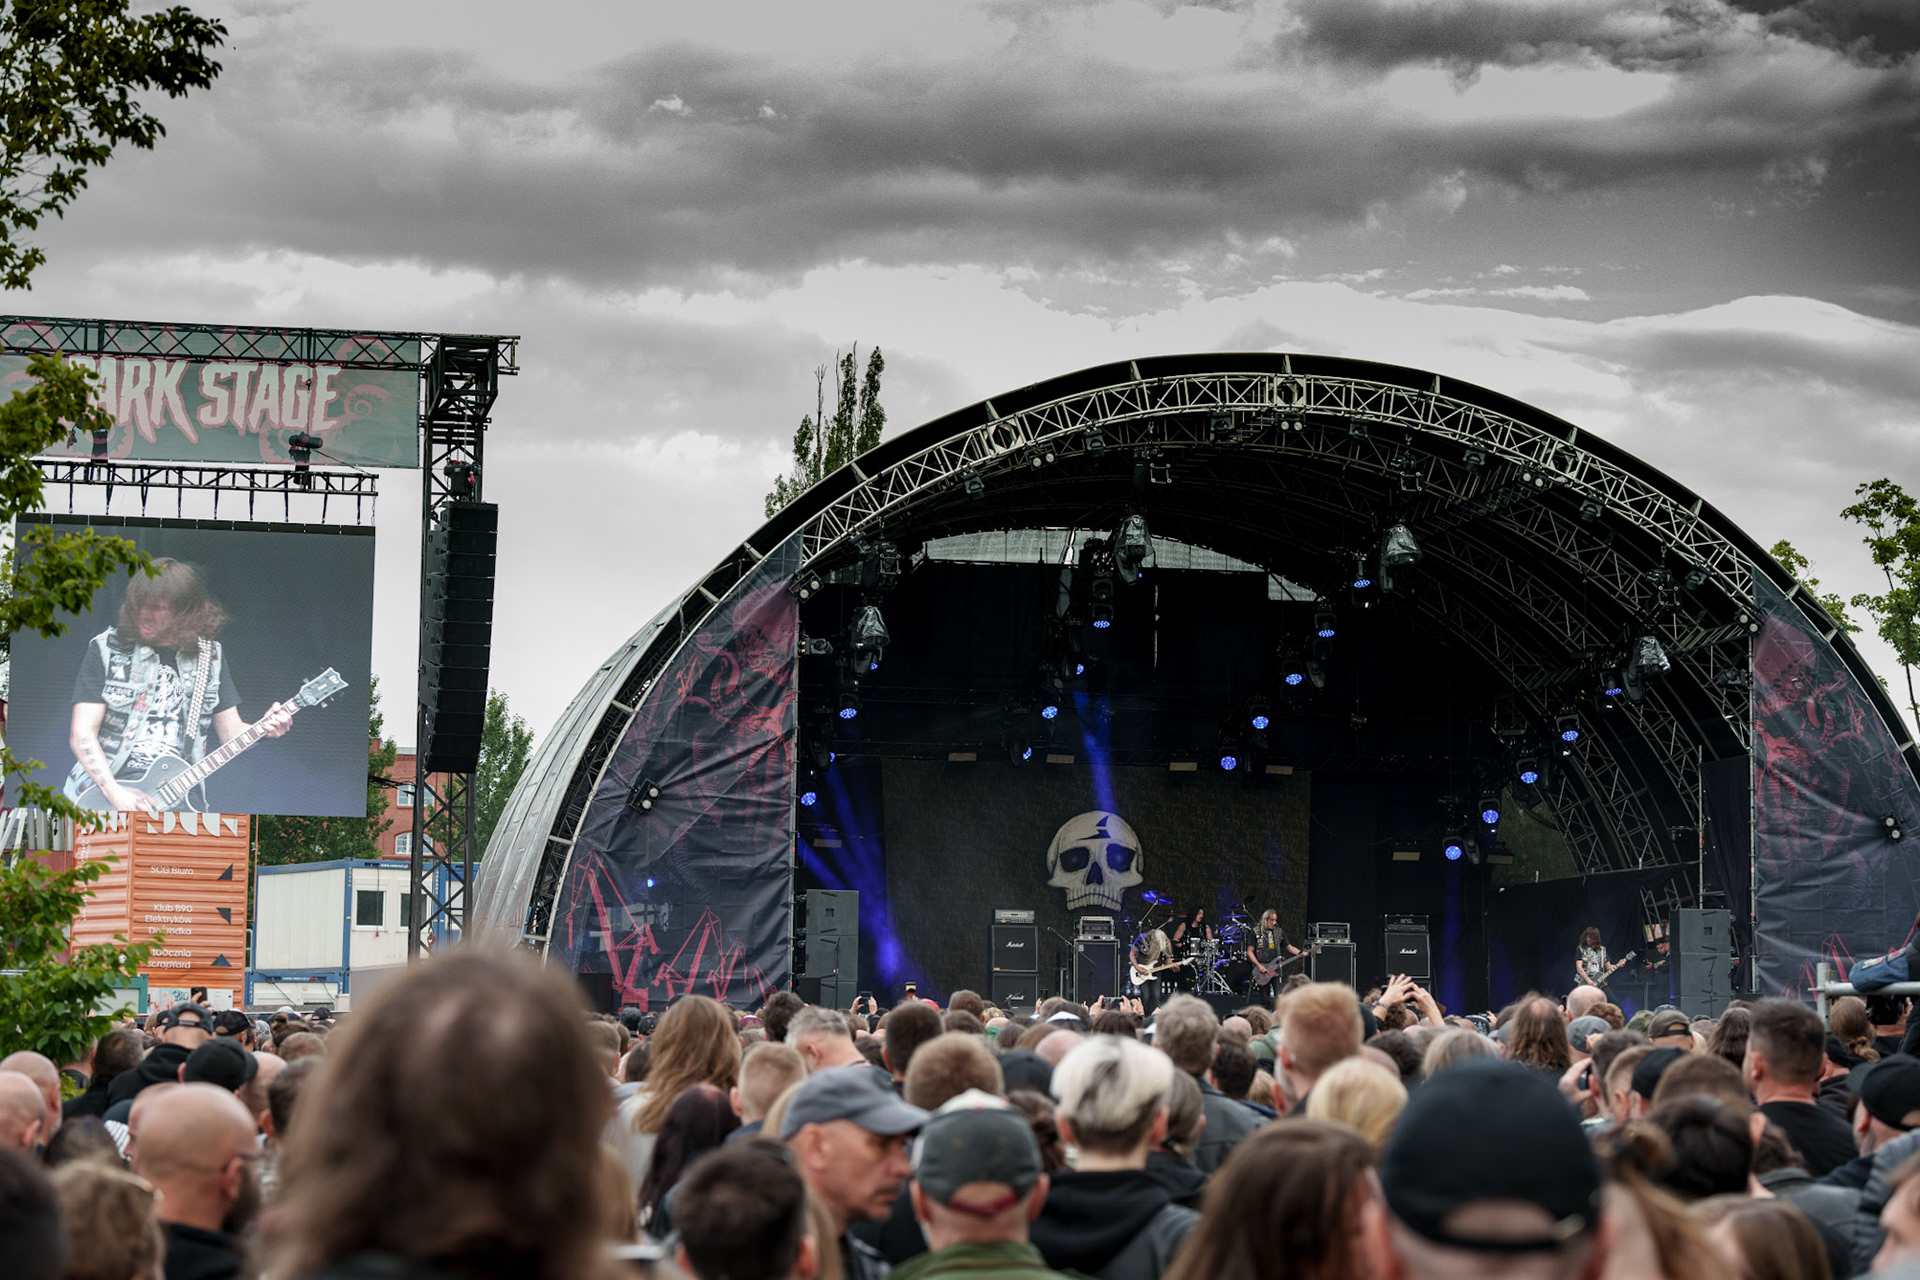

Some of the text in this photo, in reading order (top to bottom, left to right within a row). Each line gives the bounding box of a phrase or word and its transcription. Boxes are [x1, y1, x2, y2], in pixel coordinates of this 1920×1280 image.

[199, 360, 342, 434] STAGE
[150, 865, 194, 875] SCG Biuro
[153, 904, 173, 912] Klub
[144, 914, 192, 924] Elektryków
[147, 960, 191, 970] scrapYard
